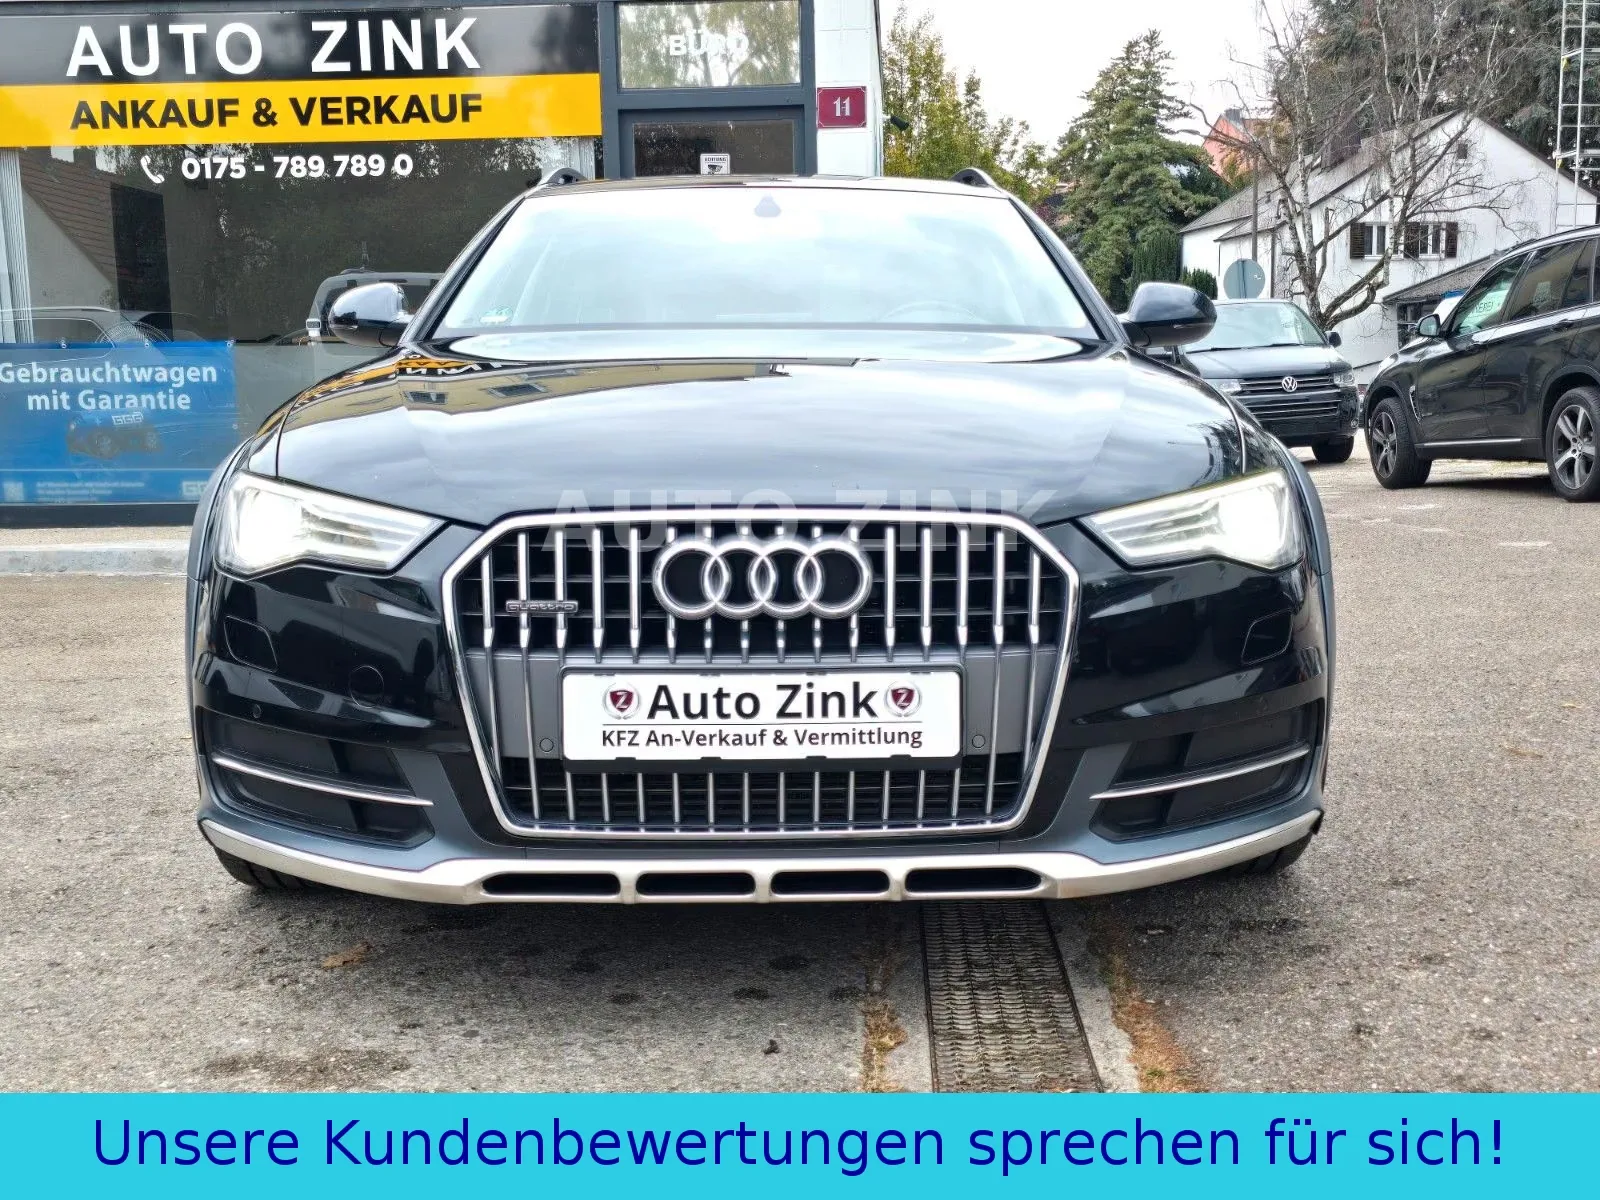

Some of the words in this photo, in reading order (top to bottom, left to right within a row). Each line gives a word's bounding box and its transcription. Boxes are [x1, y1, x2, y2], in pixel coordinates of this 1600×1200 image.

[66, 23, 262, 77] AUTO
[310, 17, 481, 73] ZINK
[70, 98, 239, 130] ANKAUF
[252, 98, 277, 127] &
[289, 94, 482, 126] VERKAUF
[833, 96, 850, 117] 11
[181, 155, 246, 180] 0175
[273, 155, 325, 178] 789
[333, 155, 384, 177] 789
[393, 154, 413, 176] 0
[0, 362, 217, 387] Gebrauchtwagen
[28, 389, 70, 410] mit
[78, 389, 191, 410] Garantie
[647, 685, 760, 719] Auto
[776, 682, 878, 719] Zink
[602, 731, 640, 747] KFZ
[645, 729, 767, 748] An-Verkauf
[772, 730, 788, 746] &
[795, 728, 923, 749] Vermittlung
